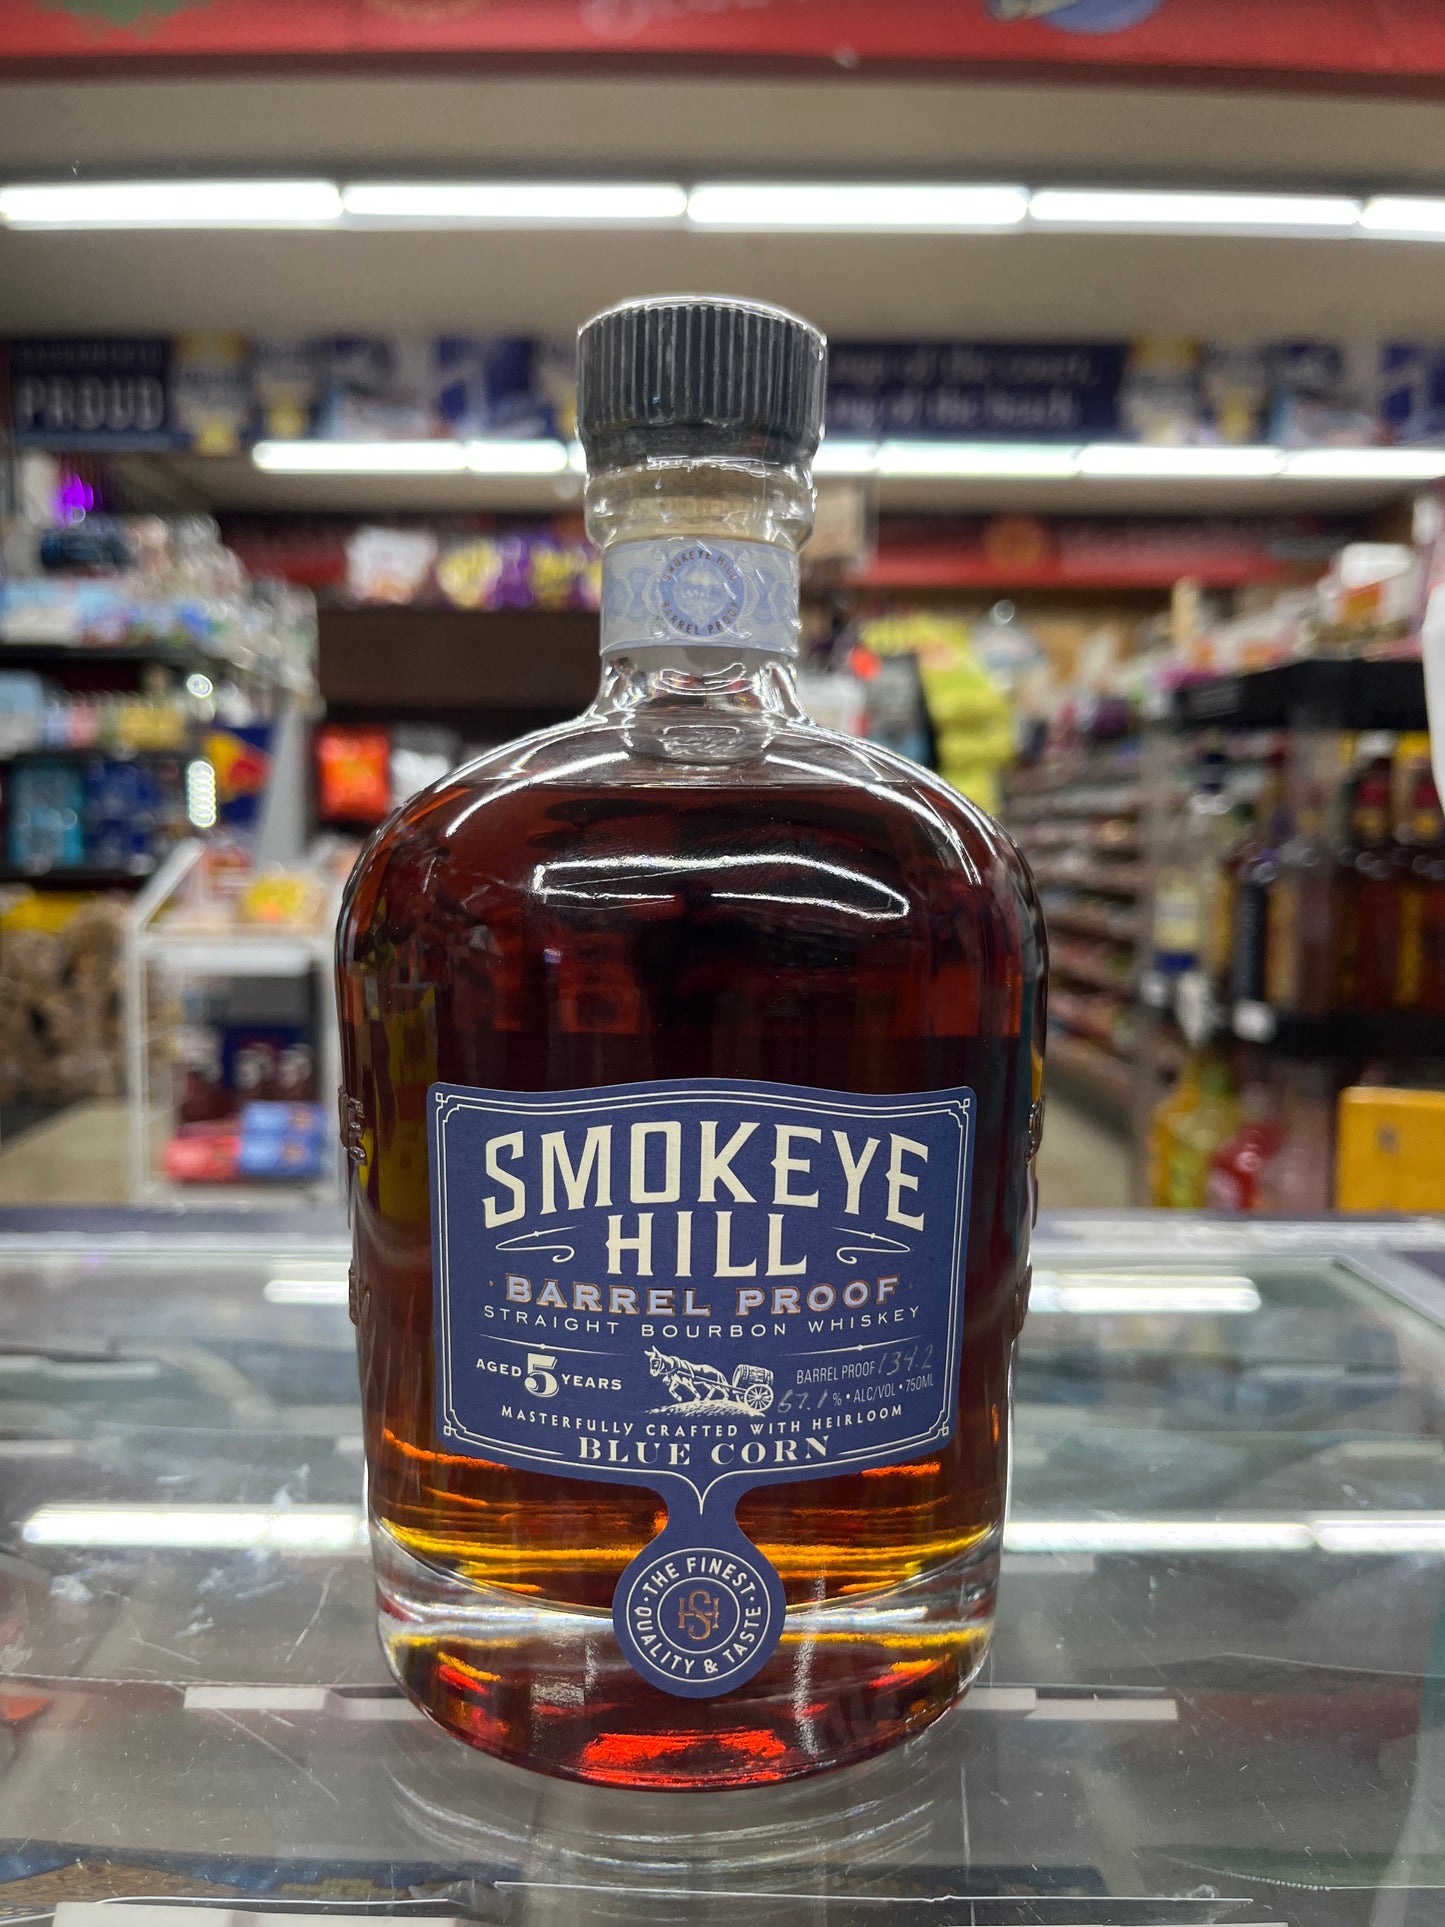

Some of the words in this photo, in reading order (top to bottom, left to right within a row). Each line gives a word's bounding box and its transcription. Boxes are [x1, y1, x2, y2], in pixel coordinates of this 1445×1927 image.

[14, 376, 164, 431] PROUD
[661, 550, 711, 582] SMOKEYE
[716, 556, 738, 582] HILL
[662, 600, 701, 635] BARREL
[707, 601, 739, 635] PROOF
[481, 1120, 929, 1232] SMOKEYE
[605, 1210, 807, 1277] HILL
[505, 1273, 711, 1317] BARREL
[736, 1274, 900, 1317] PROOF
[484, 1305, 619, 1334] STRAIGHT
[641, 1324, 786, 1338] BOURBON
[808, 1305, 920, 1333] WHISKEY
[476, 1358, 522, 1377] AGED
[524, 1353, 560, 1398] 5
[561, 1373, 622, 1390] YEARS
[796, 1366, 839, 1384] BARREL
[841, 1360, 876, 1379] PROOF
[877, 1344, 934, 1376] 134.2
[777, 1389, 829, 1413] 67.1
[853, 1383, 896, 1403] ALC/VOL
[905, 1373, 934, 1392] 750ML
[501, 1405, 634, 1436] MASTERFULLY
[646, 1423, 738, 1437] CRAFTED
[750, 1420, 800, 1435] WITH
[812, 1404, 902, 1431] HEIRLOOM
[578, 1436, 691, 1465] BLUE
[710, 1435, 830, 1465] CORN
[642, 1562, 680, 1595] THE
[686, 1557, 756, 1595] FINEST
[634, 1606, 696, 1674] QUALITY
[703, 1658, 719, 1674] &
[722, 1606, 762, 1664] TASTE
